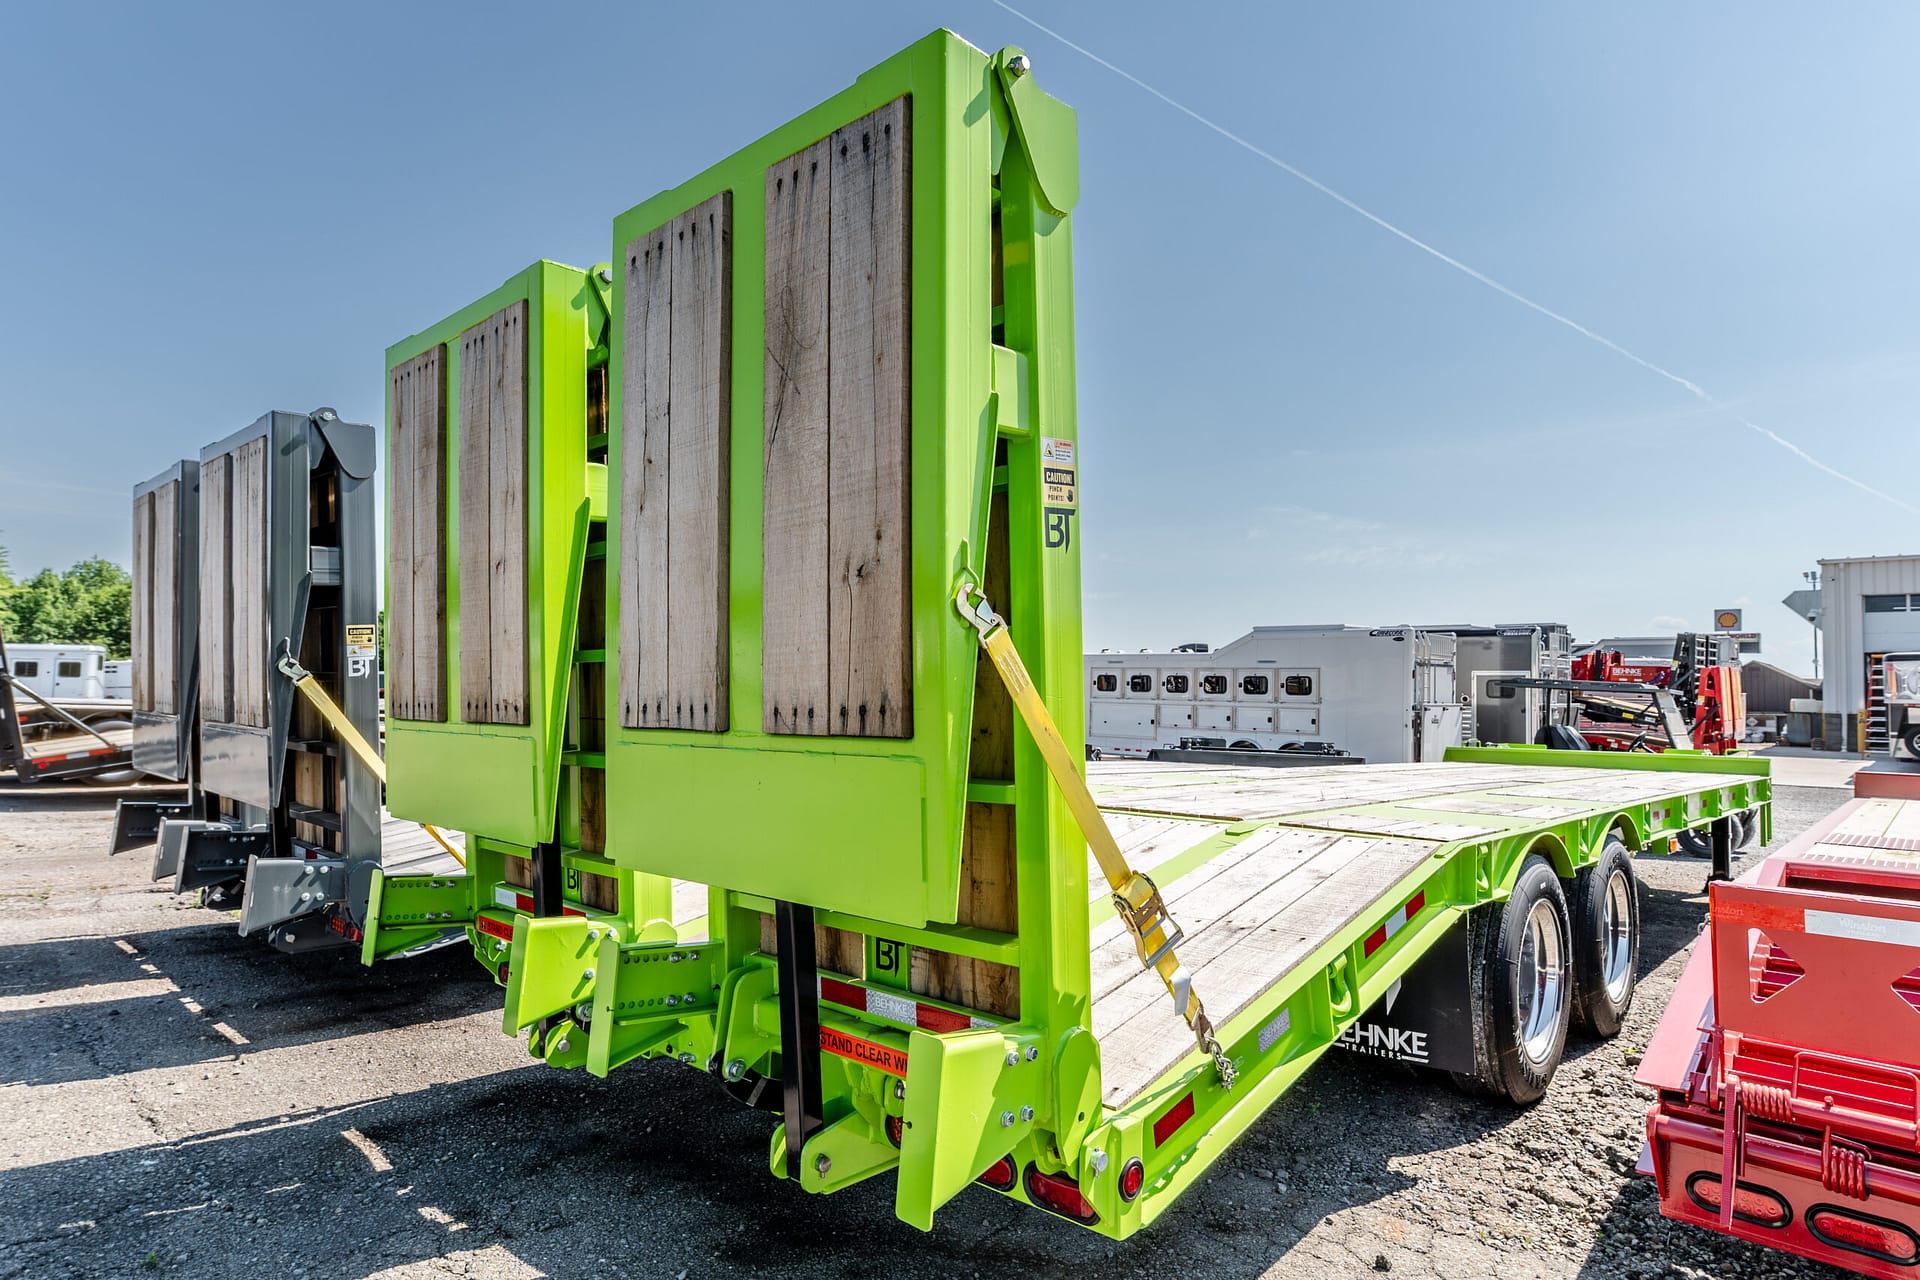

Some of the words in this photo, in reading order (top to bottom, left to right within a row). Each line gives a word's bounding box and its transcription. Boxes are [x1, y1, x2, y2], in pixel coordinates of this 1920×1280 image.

[1044, 507, 1076, 554] BT
[347, 656, 375, 679] BT
[876, 936, 905, 978] BT
[820, 1031, 853, 1054] STAND
[855, 1043, 891, 1068] CLEAR
[1345, 1042, 1402, 1061] TRAILERS
